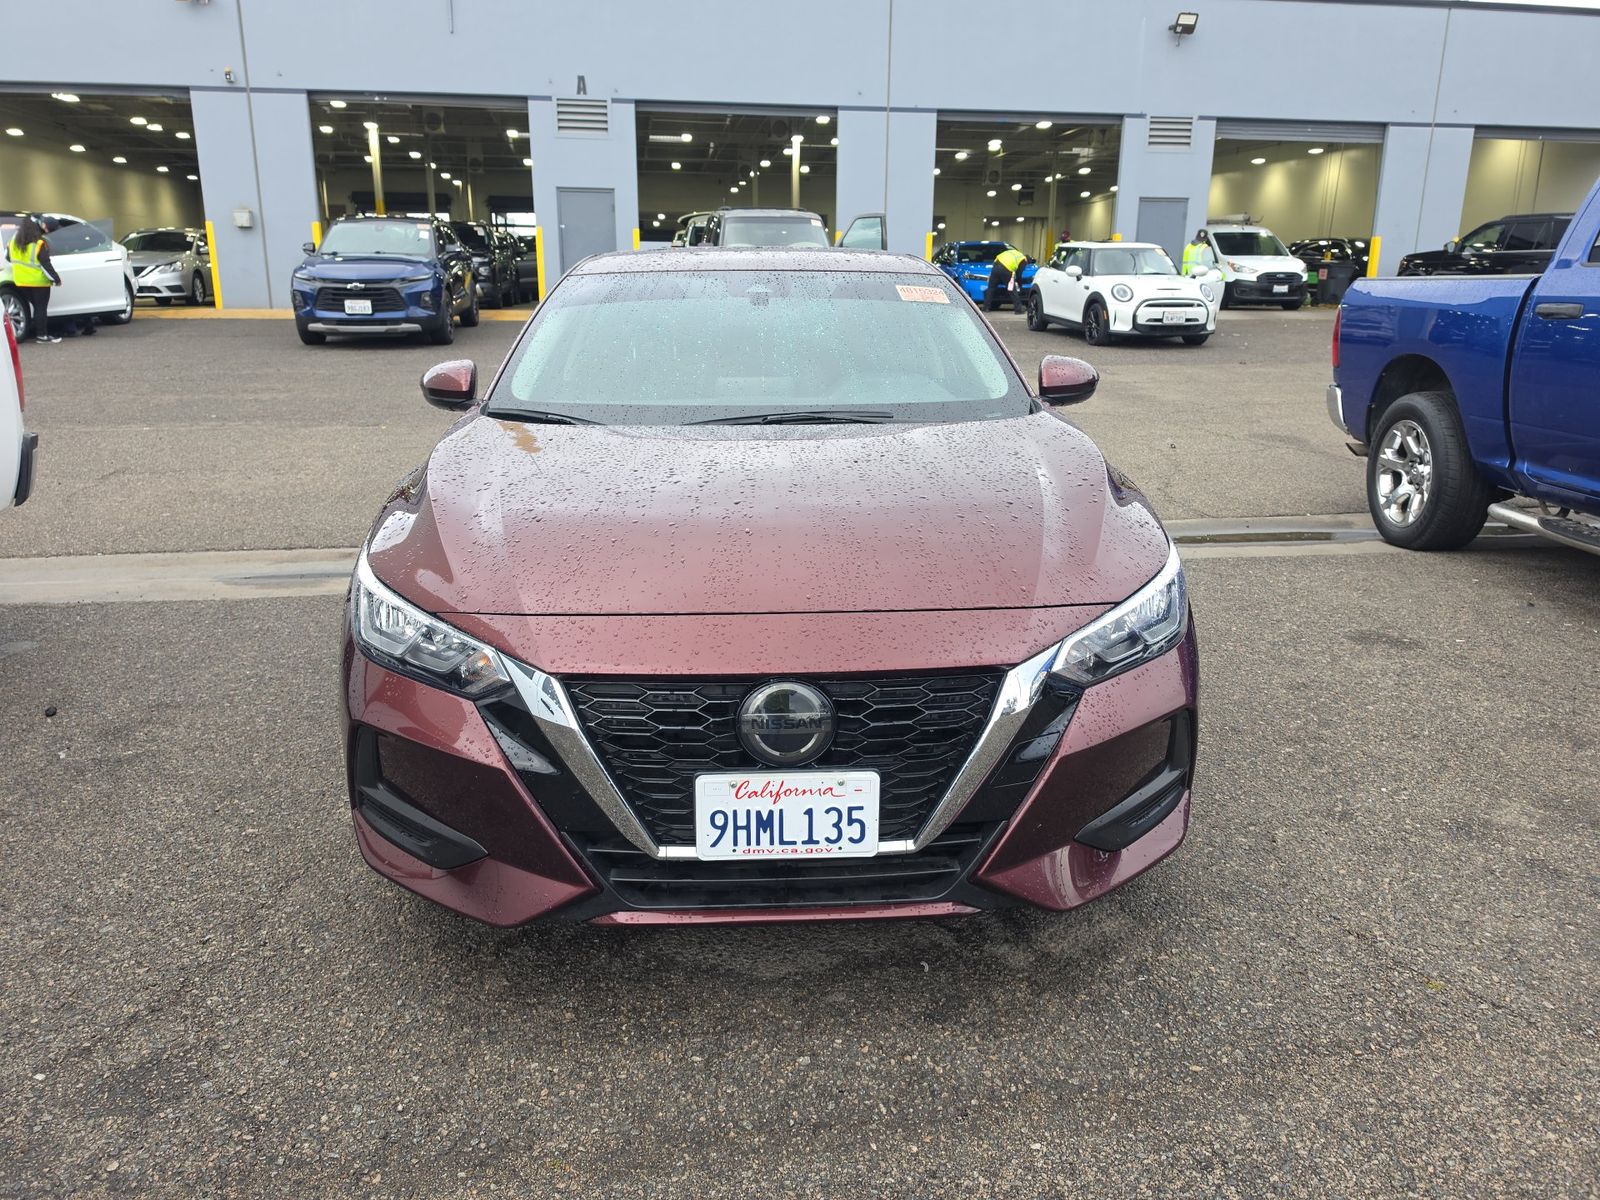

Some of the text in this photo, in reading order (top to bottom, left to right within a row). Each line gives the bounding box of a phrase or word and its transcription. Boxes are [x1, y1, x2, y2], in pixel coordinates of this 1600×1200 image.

[576, 75, 587, 95] A
[751, 718, 822, 730] NISSAN
[735, 780, 846, 805] California
[709, 805, 866, 848] 9HML135
[742, 846, 833, 855] dmv.ca.gov
